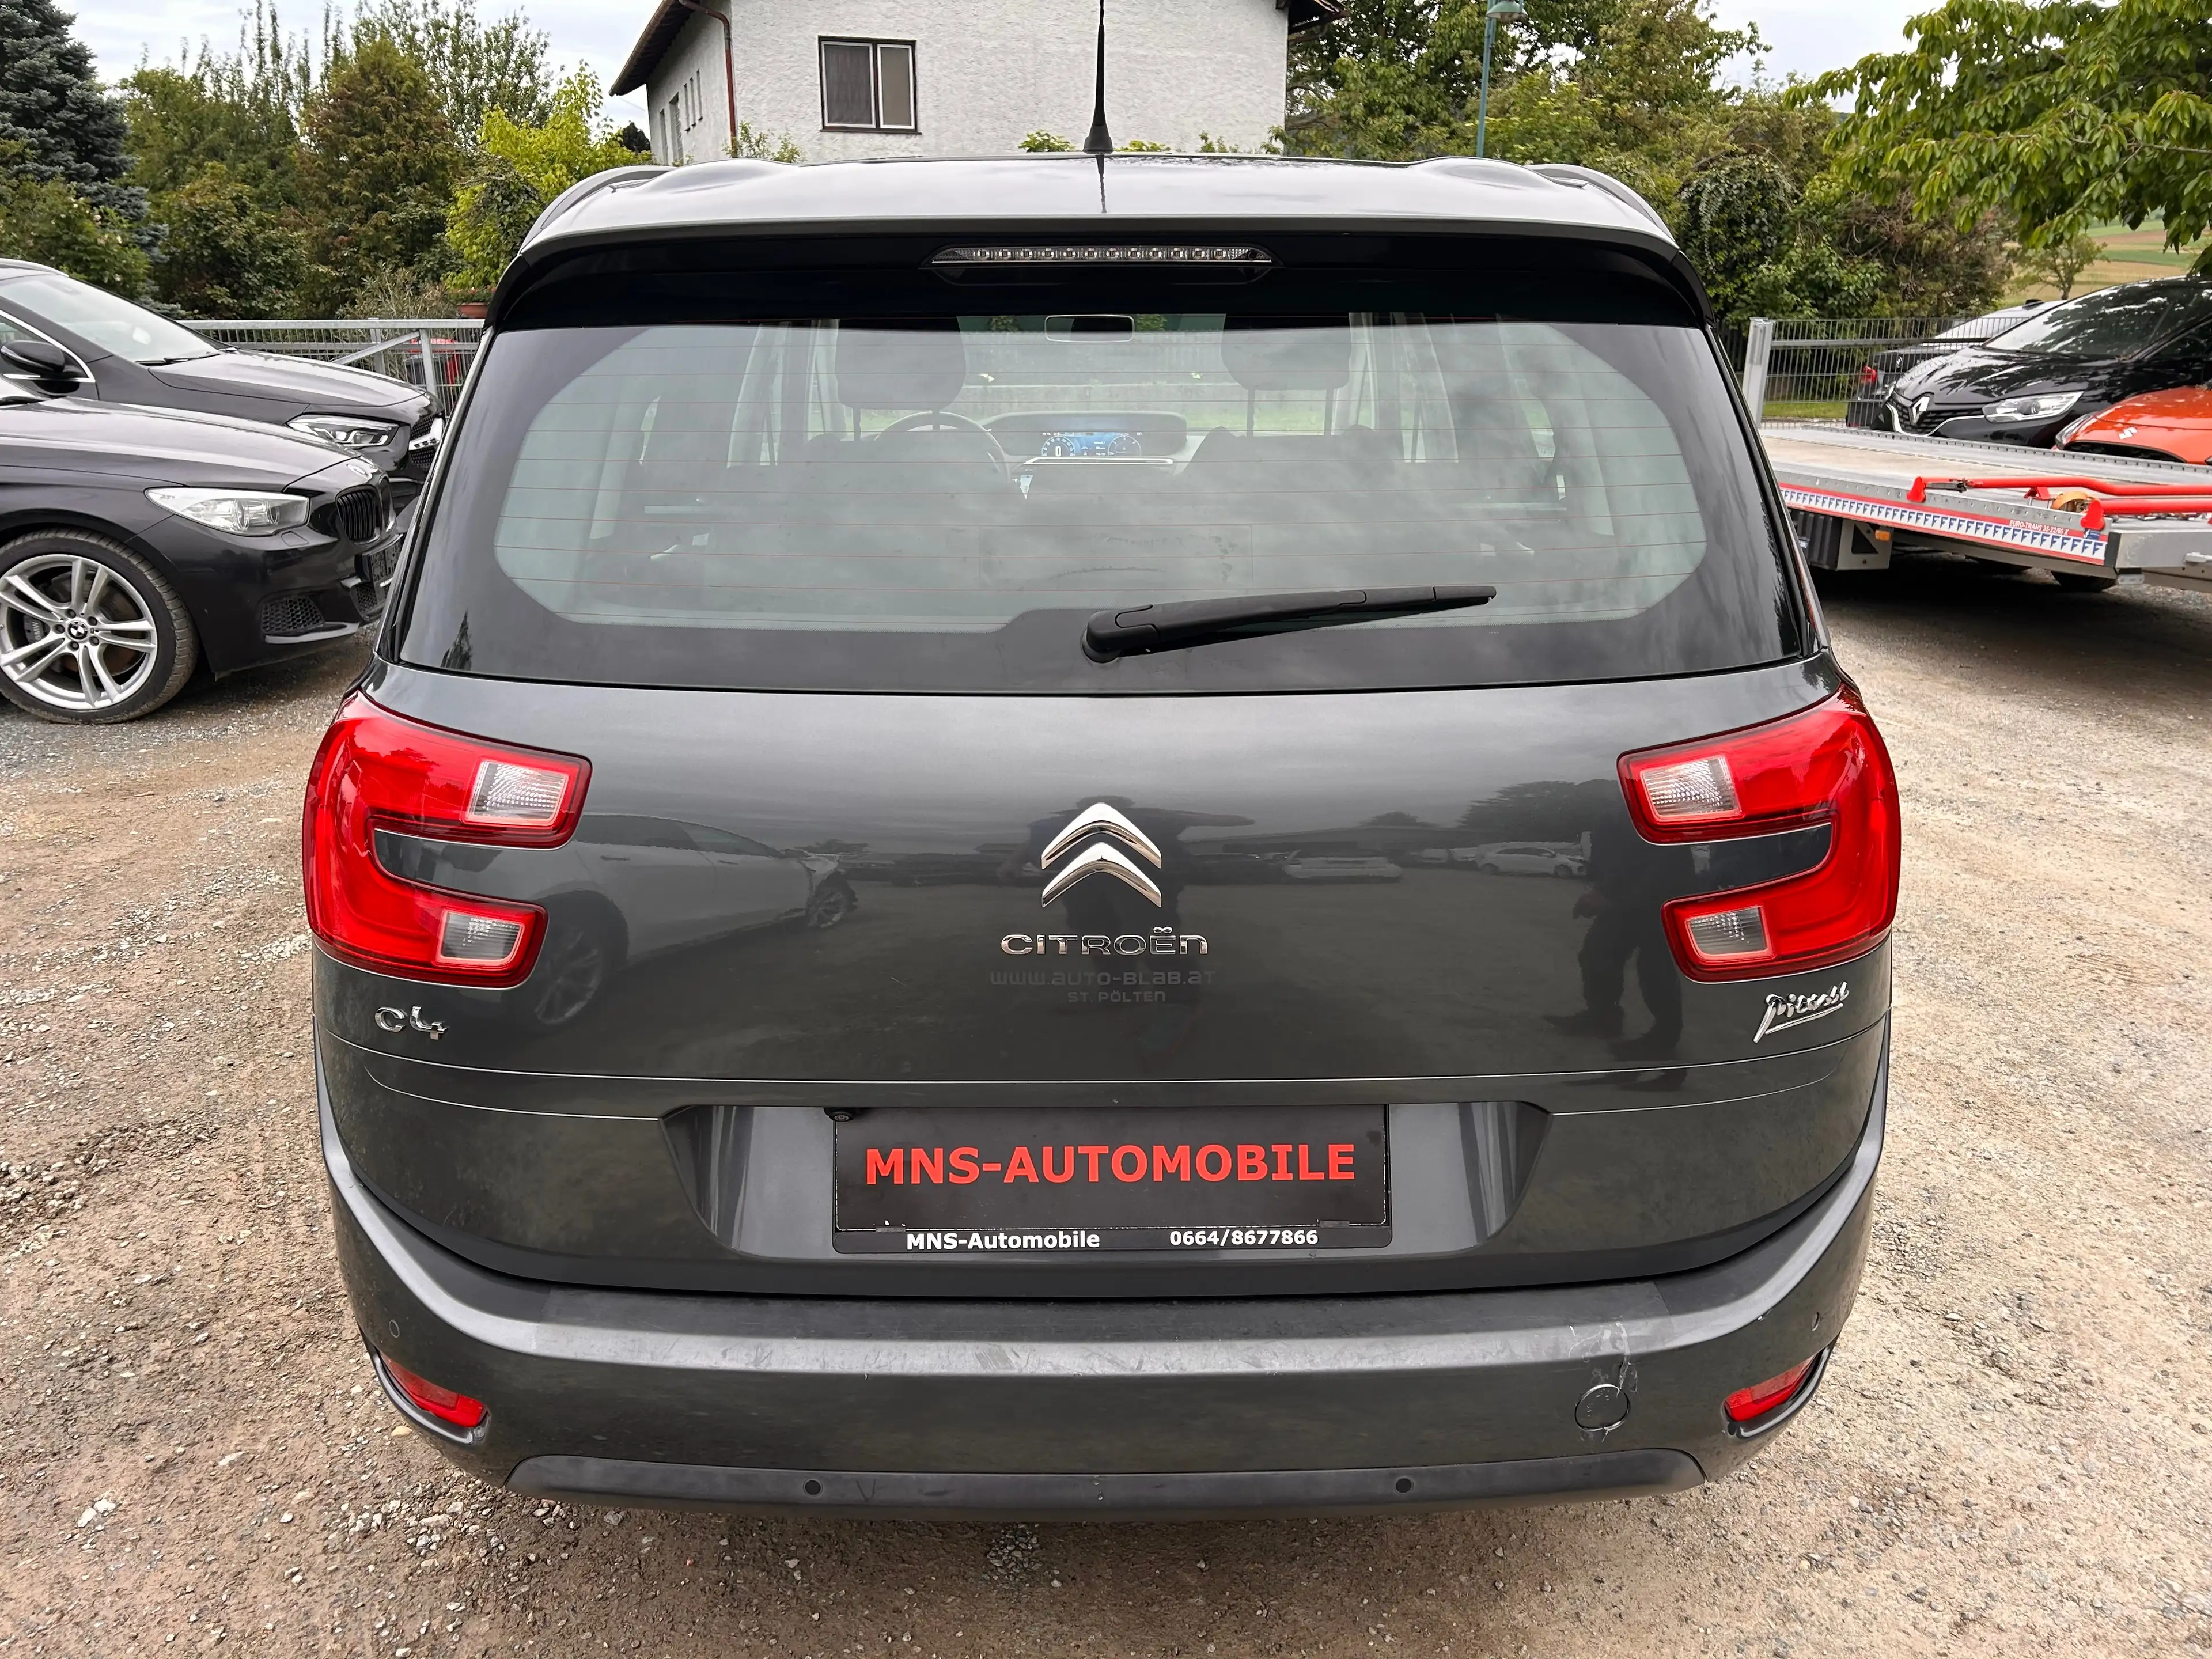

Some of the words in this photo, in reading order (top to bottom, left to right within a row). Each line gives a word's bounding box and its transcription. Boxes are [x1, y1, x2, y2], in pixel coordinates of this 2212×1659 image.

[2009, 519, 2043, 531] EURO-TRANS
[1000, 926, 1208, 956] CITROËN
[1067, 991, 1093, 1003] ST.
[1098, 989, 1166, 1003] PÖLTEN
[375, 1006, 448, 1040] C4
[865, 1143, 1355, 1185] MNS-AUTOMOBILE
[906, 1230, 1100, 1250] MNS-Automobile
[1169, 1229, 1319, 1247] 0664/8677866
